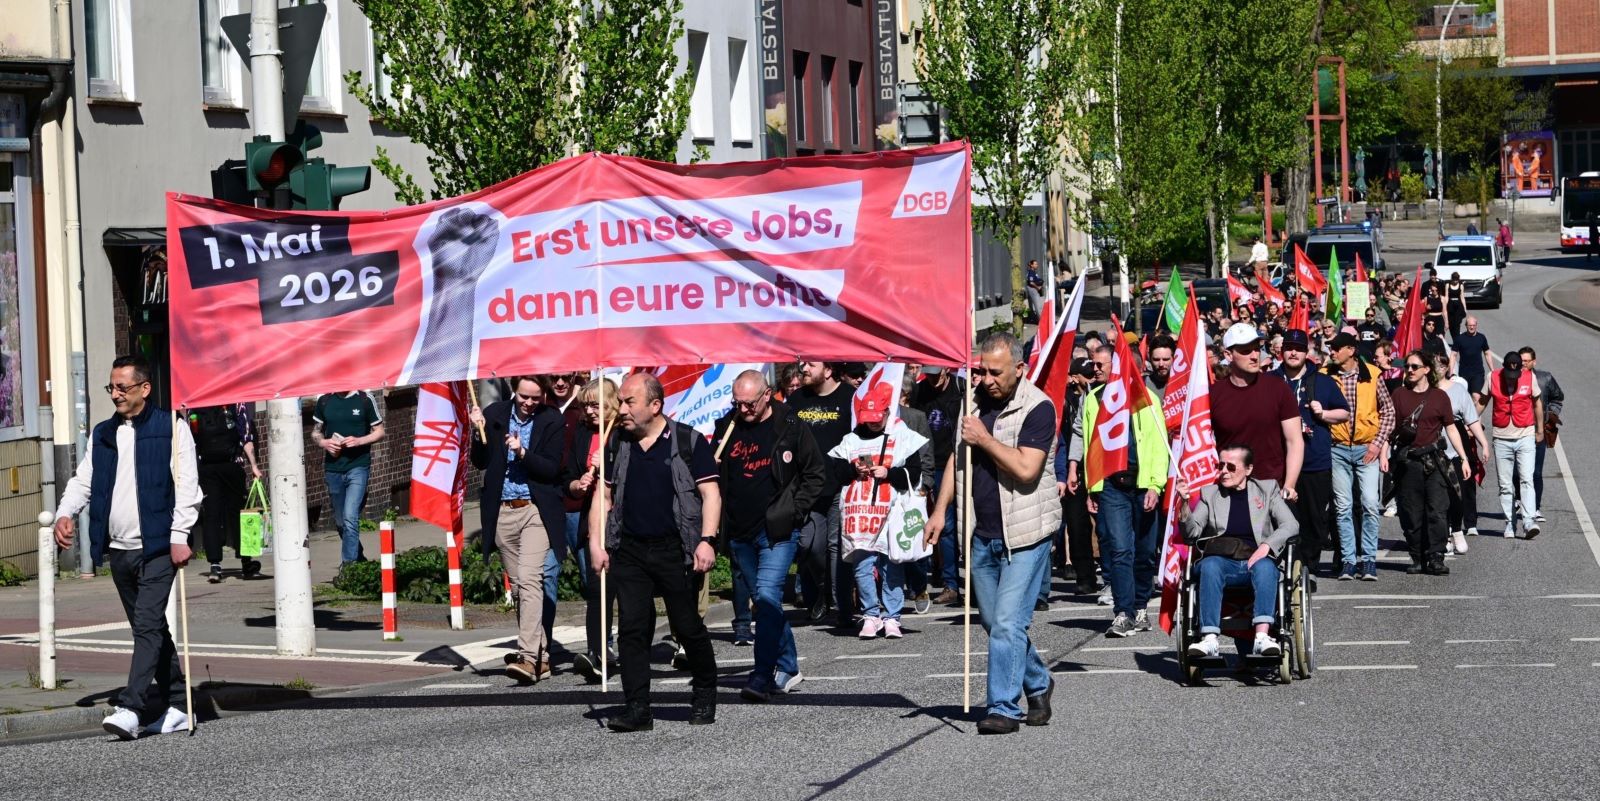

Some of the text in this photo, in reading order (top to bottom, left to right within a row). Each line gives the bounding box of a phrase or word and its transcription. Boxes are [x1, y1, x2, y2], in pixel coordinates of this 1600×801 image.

[903, 190, 948, 213] DGB
[203, 224, 324, 270] 1. Mai
[511, 204, 843, 263] Erst unsere Jobs,
[278, 266, 384, 308] 2026
[487, 272, 833, 324] dann eure Profite
[797, 409, 840, 421] GODSNAKE
[845, 516, 856, 535] IG
